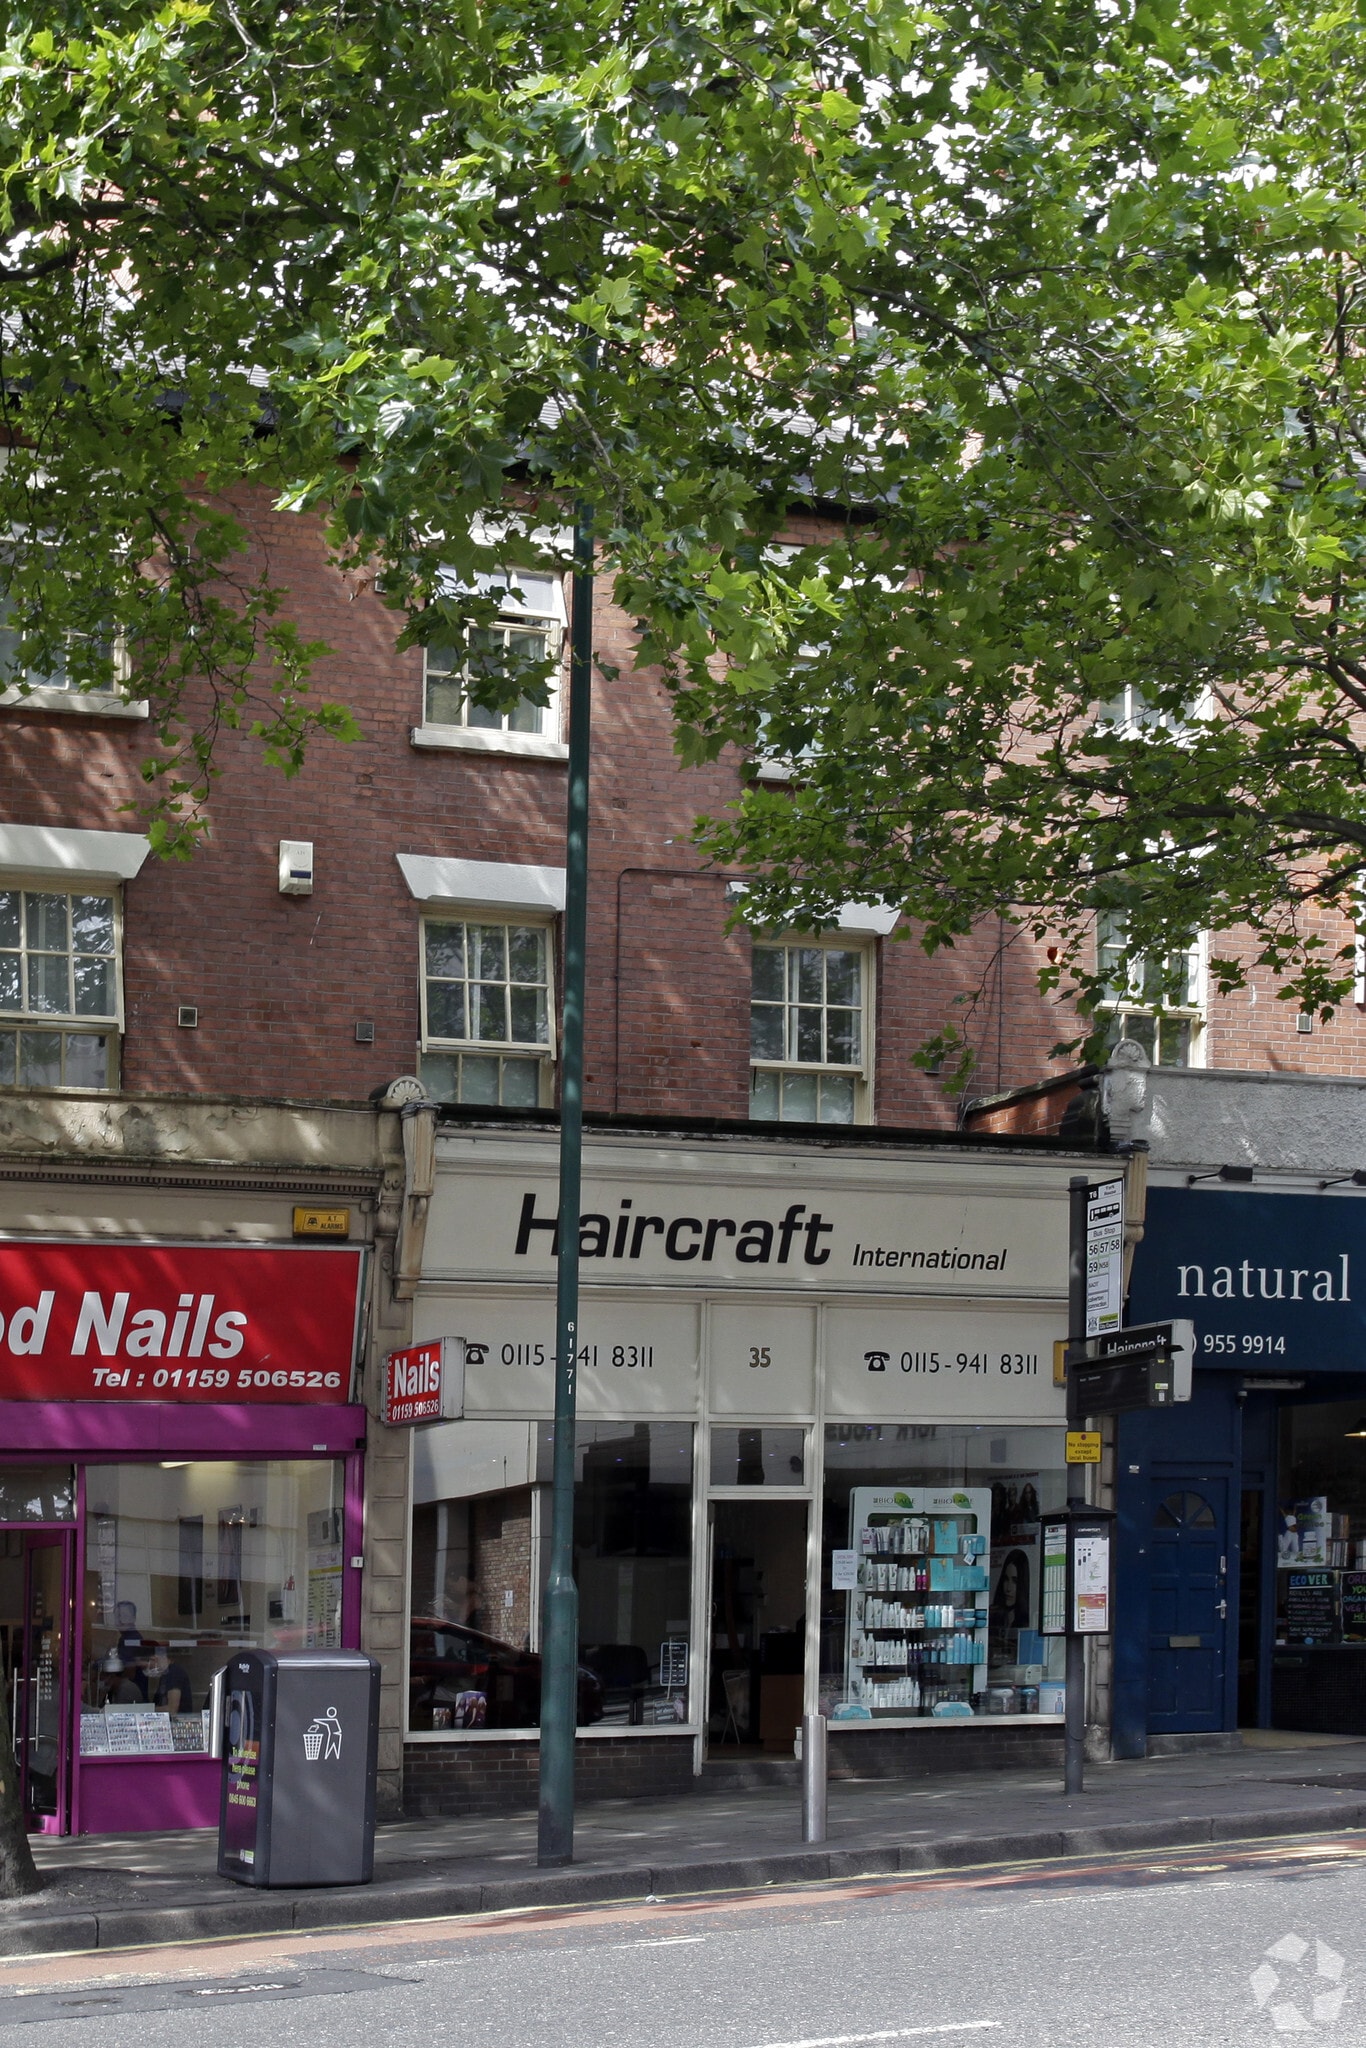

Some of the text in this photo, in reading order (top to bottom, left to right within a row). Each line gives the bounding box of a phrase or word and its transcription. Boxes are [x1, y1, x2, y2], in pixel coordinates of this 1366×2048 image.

[514, 1193, 1007, 1272] Haircraft International
[1104, 1227, 1116, 1235] Stop
[1088, 1239, 1120, 1256] 56 57 58
[1088, 1261, 1098, 1273] 59
[1177, 1253, 1351, 1302] natural
[0, 1290, 248, 1359] d Nails
[1203, 1334, 1236, 1354] 955
[1242, 1336, 1286, 1354] 9914
[611, 1345, 653, 1368] 8311
[749, 1346, 771, 1368] 35
[1000, 1353, 1038, 1375] 8311
[152, 1368, 230, 1388] 01159
[236, 1369, 341, 1389] 506526
[393, 1351, 440, 1399] Nails
[392, 1398, 439, 1421] 01159 506526
[232, 1746, 257, 1760] To advertise
[231, 1763, 256, 1776] here please
[236, 1780, 250, 1791] phone
